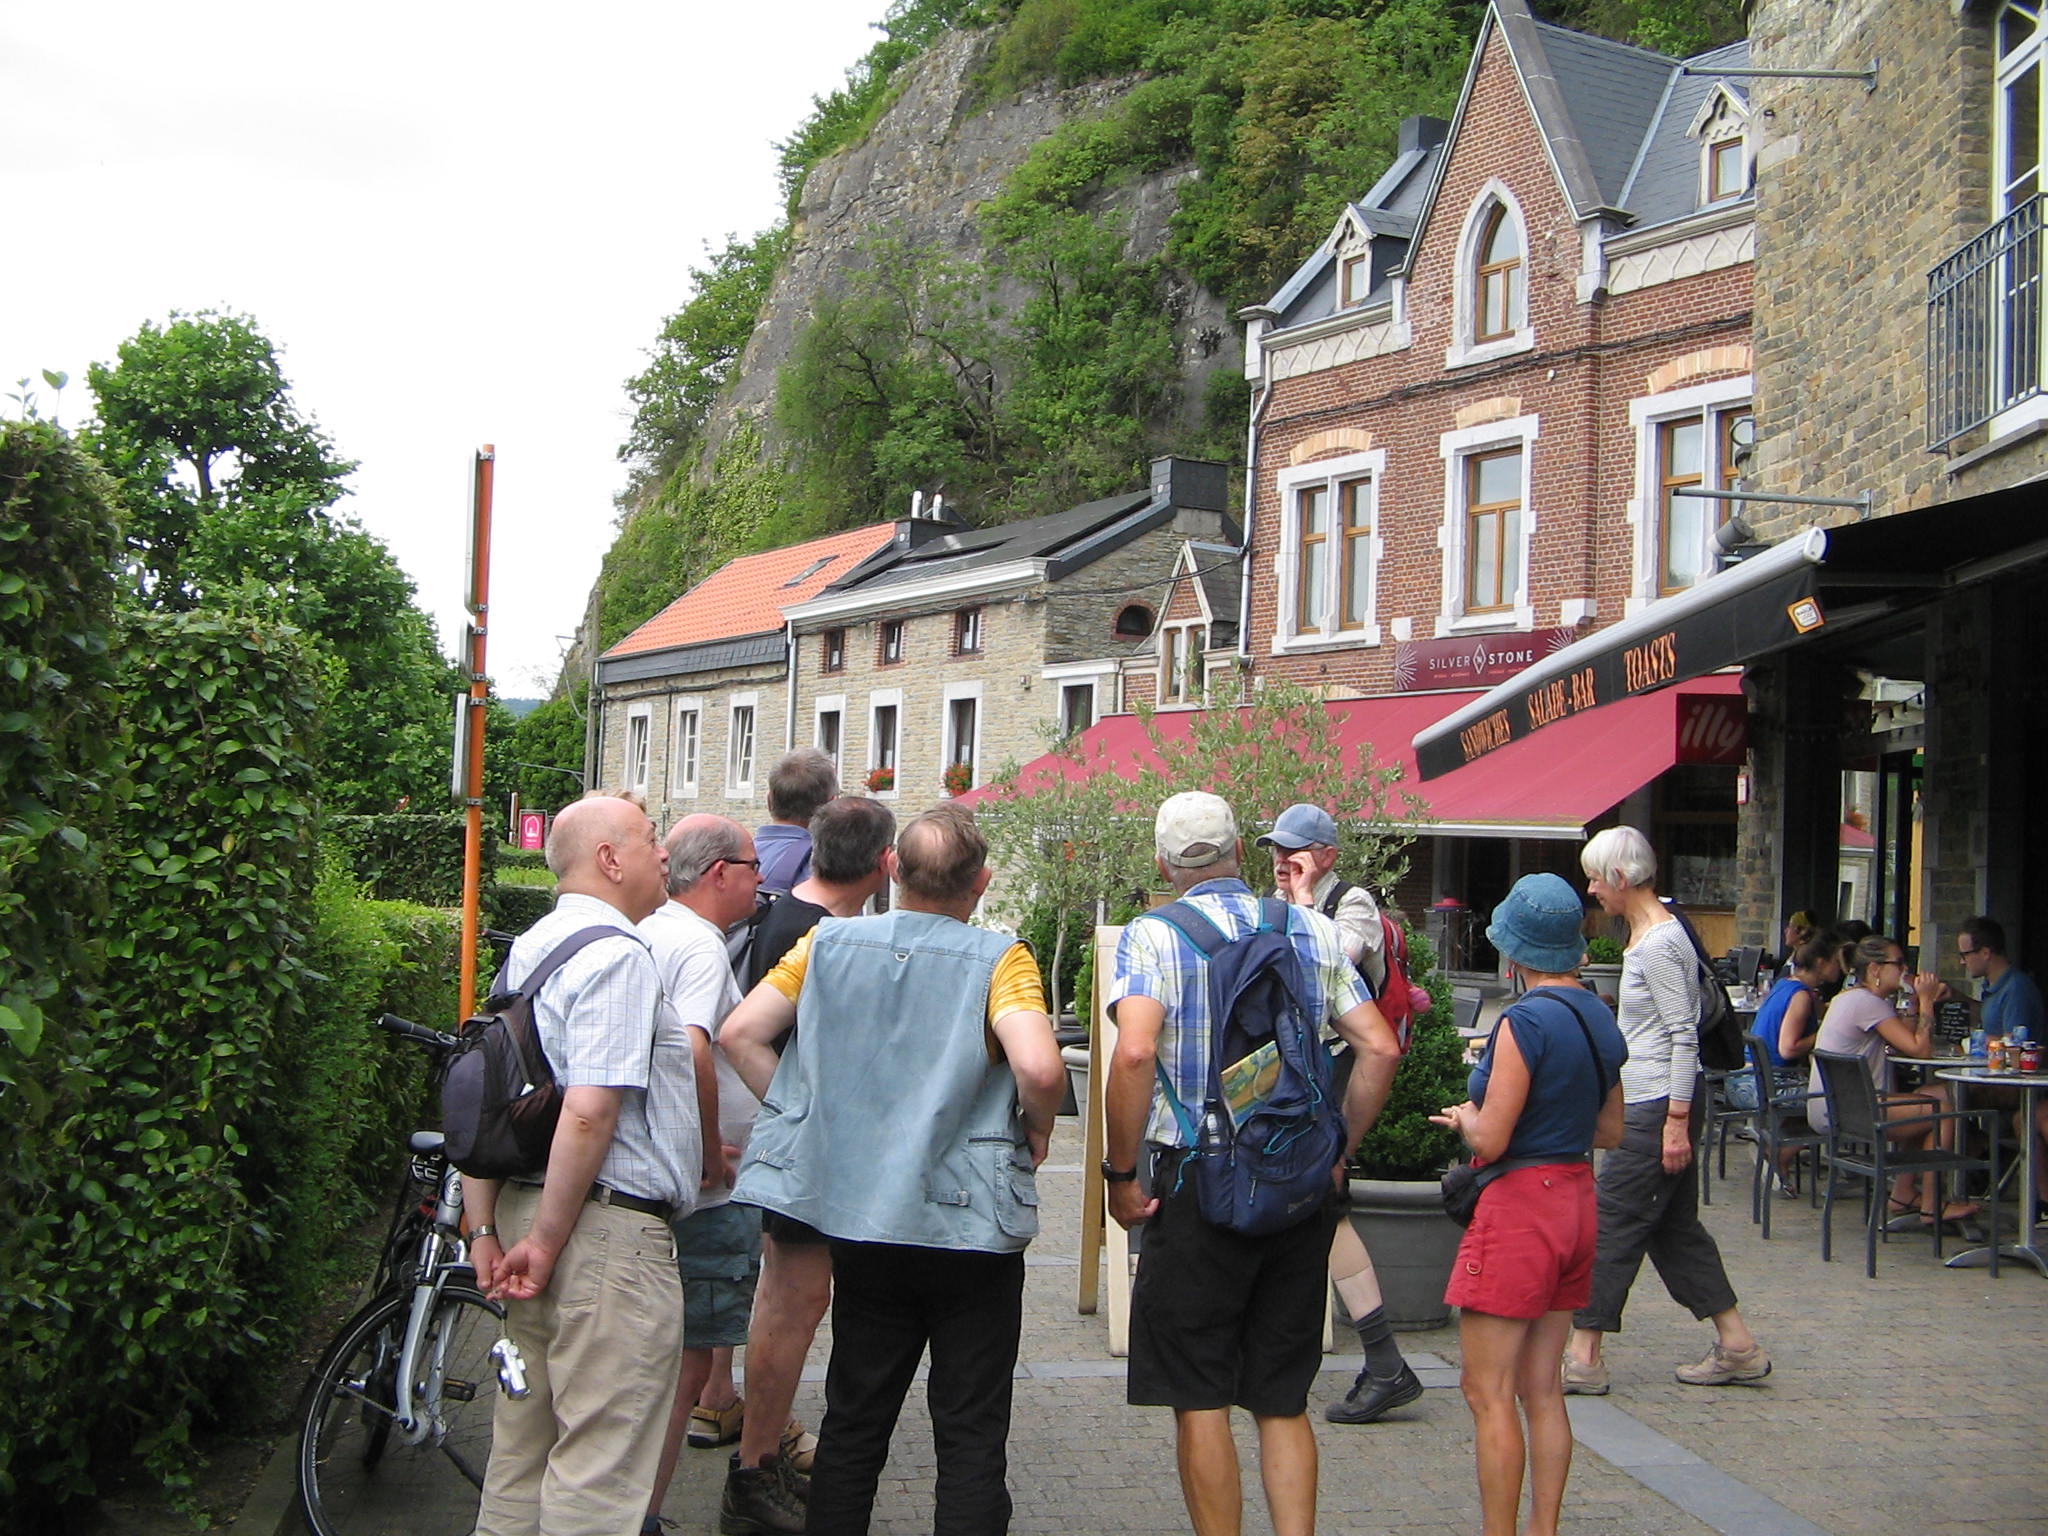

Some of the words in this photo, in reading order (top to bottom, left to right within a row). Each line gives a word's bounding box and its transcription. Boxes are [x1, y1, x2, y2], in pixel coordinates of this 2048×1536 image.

[1429, 655, 1471, 670] SILVER
[1488, 649, 1534, 665] STONE
[1623, 632, 1677, 693] TOASTS
[1680, 703, 1745, 760] illy
